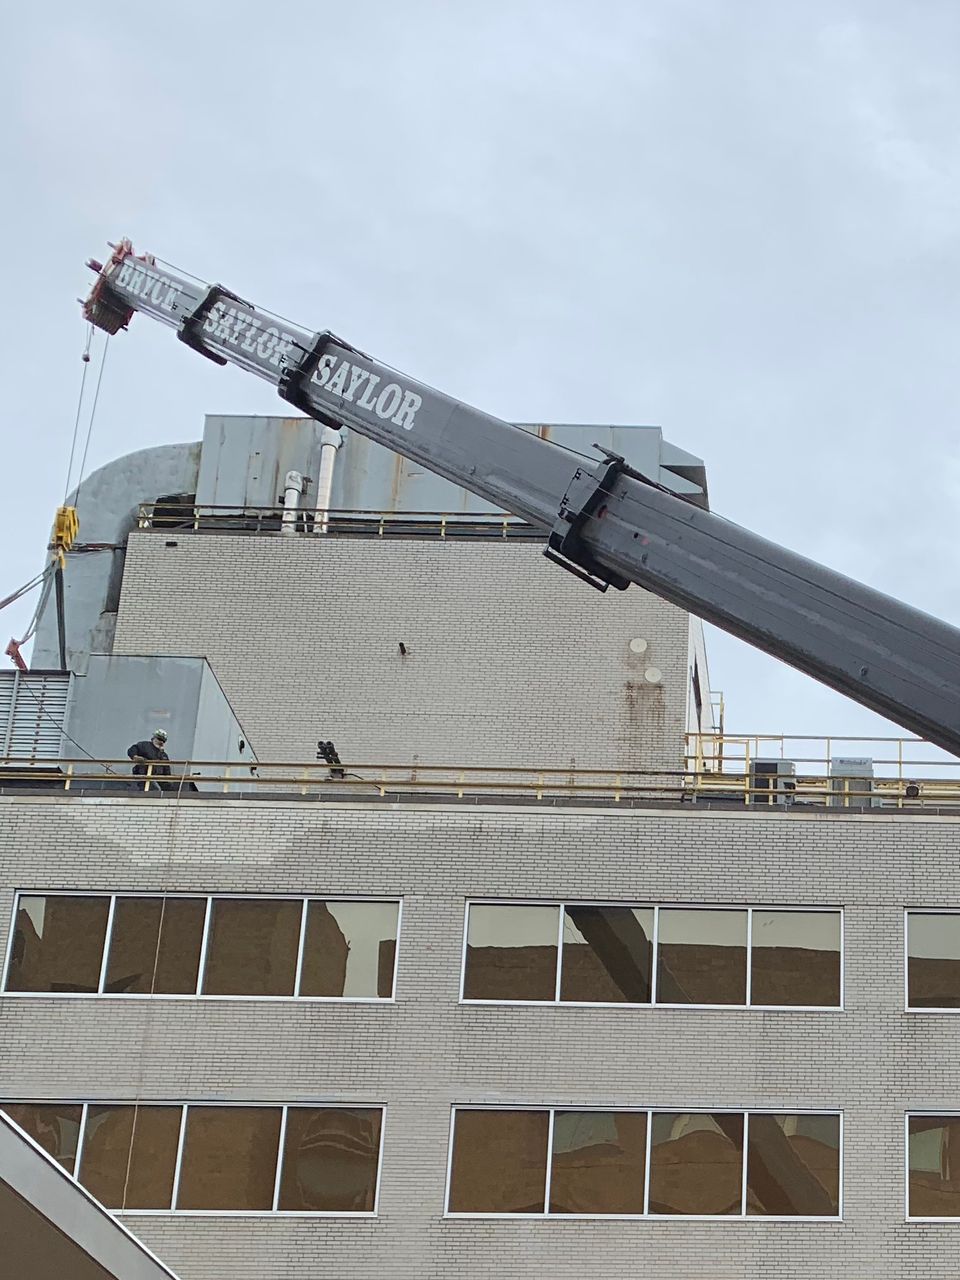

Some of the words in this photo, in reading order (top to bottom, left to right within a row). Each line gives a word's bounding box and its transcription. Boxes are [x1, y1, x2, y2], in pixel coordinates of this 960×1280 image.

[115, 259, 183, 311] BRYCE
[203, 301, 297, 369] SAYLOR
[311, 354, 422, 430] SAYLOR
